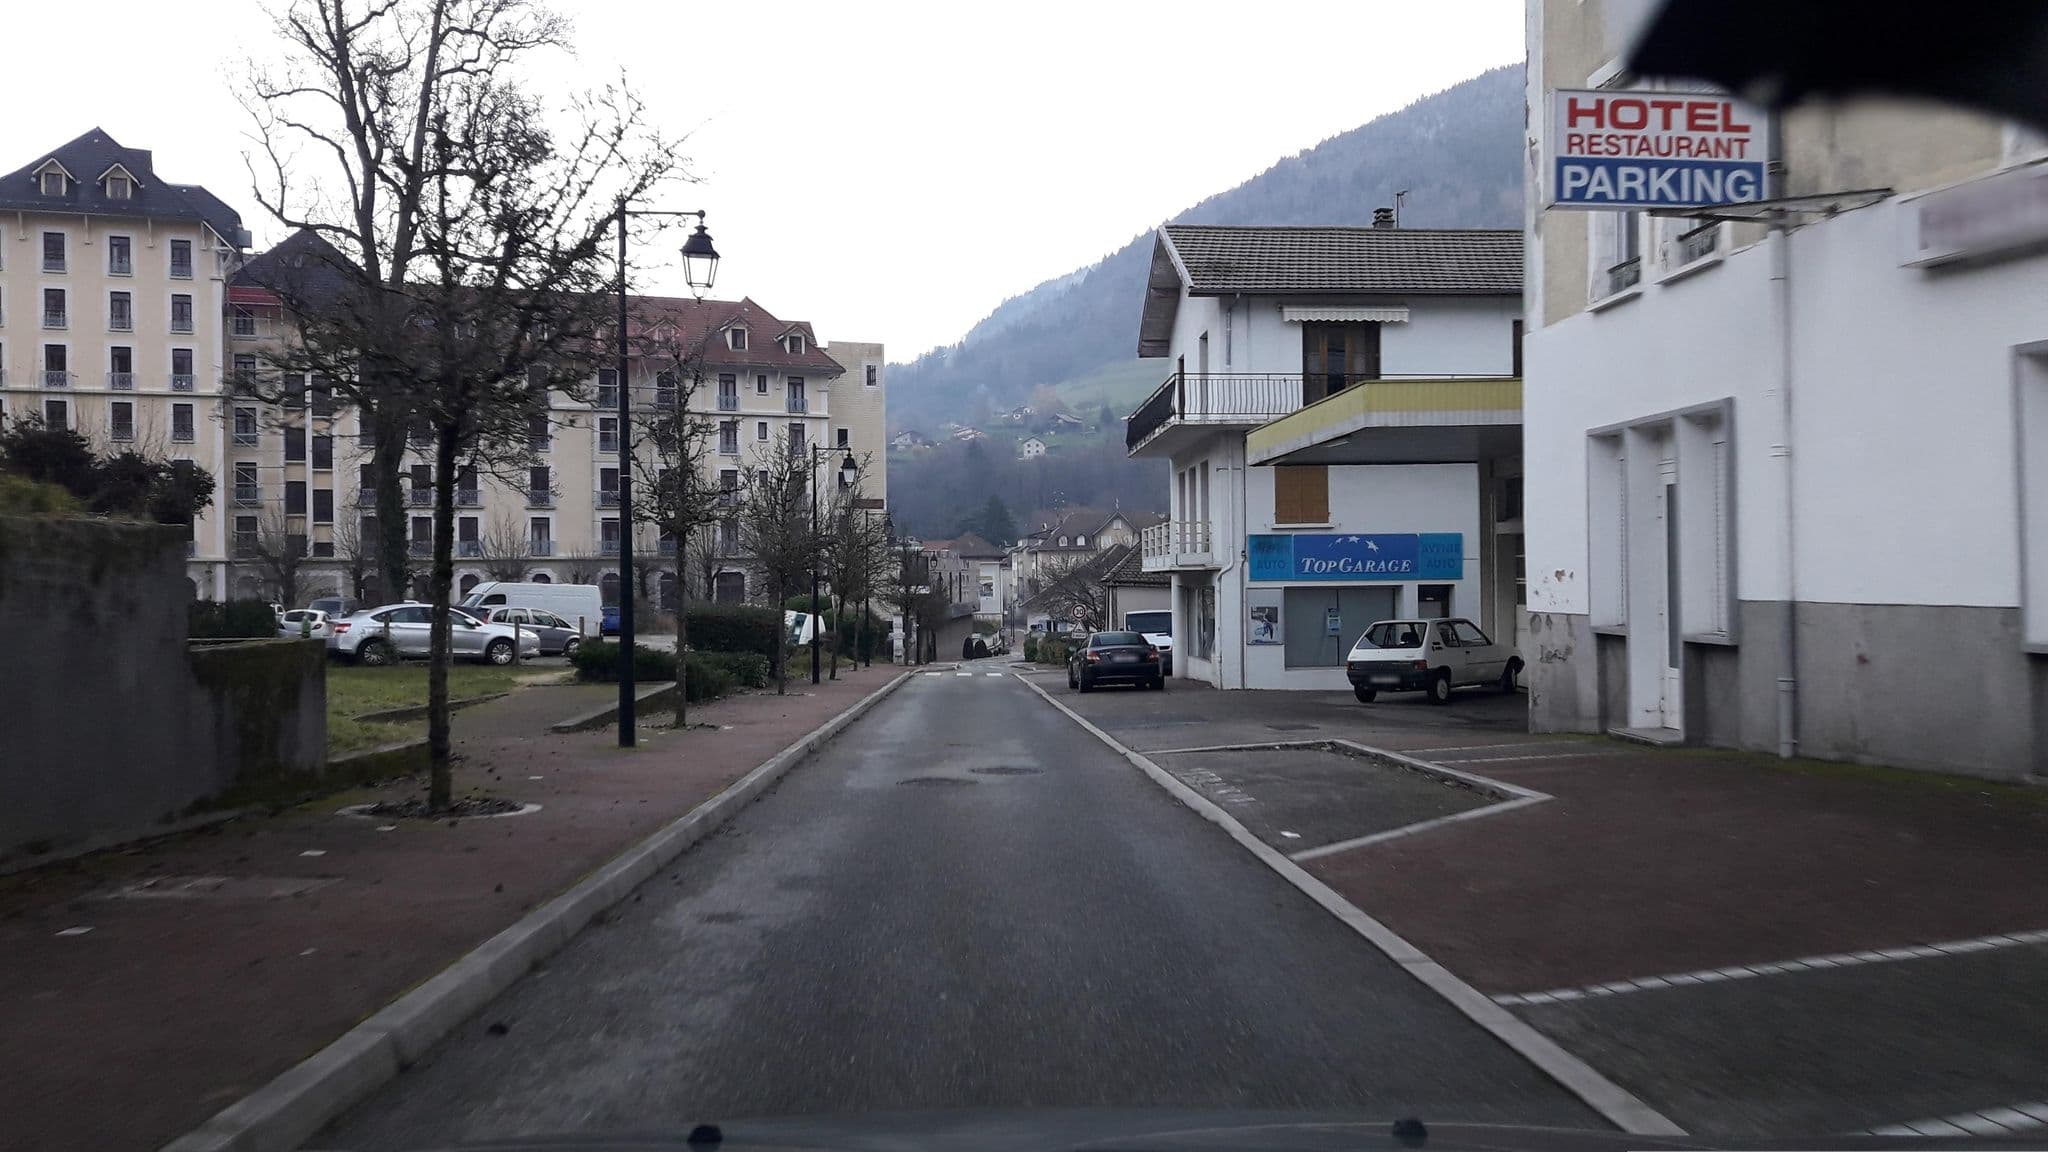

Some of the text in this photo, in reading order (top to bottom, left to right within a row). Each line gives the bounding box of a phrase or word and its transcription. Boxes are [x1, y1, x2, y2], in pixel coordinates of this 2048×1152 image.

[1567, 97, 1752, 133] HOTEL
[1567, 133, 1750, 159] RESTAURANT
[1562, 165, 1756, 203] PARKING
[1256, 559, 1286, 570] AUTO
[1427, 559, 1456, 569] AUTO
